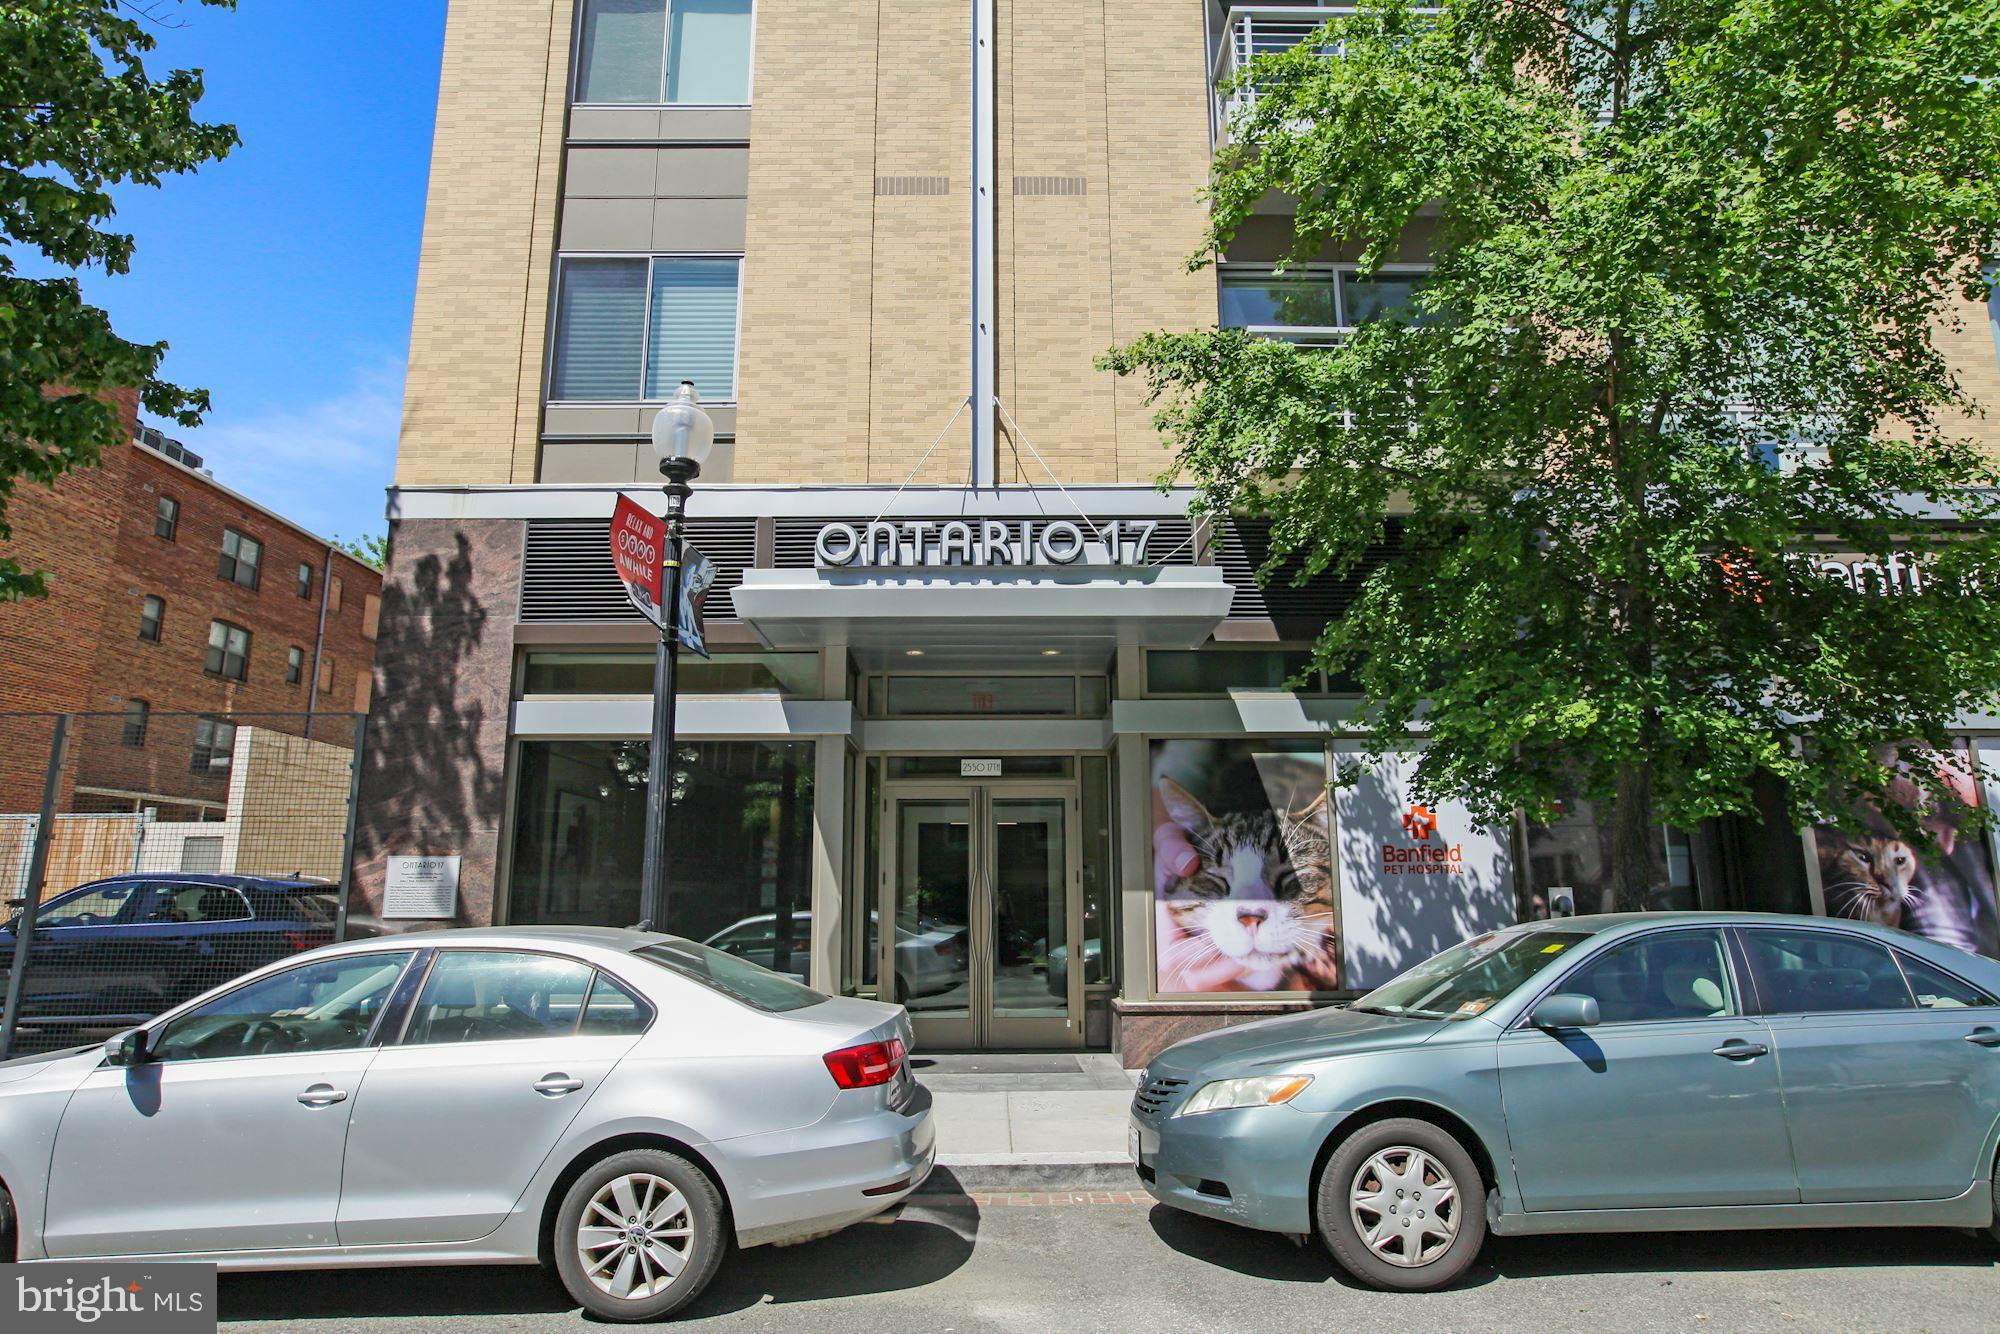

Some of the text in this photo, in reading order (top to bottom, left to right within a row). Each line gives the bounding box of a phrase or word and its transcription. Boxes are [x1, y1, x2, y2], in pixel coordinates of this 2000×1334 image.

[625, 513, 654, 540] RELAX AND
[619, 531, 655, 563] STAY
[815, 520, 1159, 566] ONTARIO 17
[619, 553, 653, 582] AWHILE
[962, 762, 985, 772] 2550
[1383, 843, 1461, 863] Banfield
[402, 861, 444, 869] ONTARIO 17
[1384, 863, 1464, 875] PET HOSPITAL
